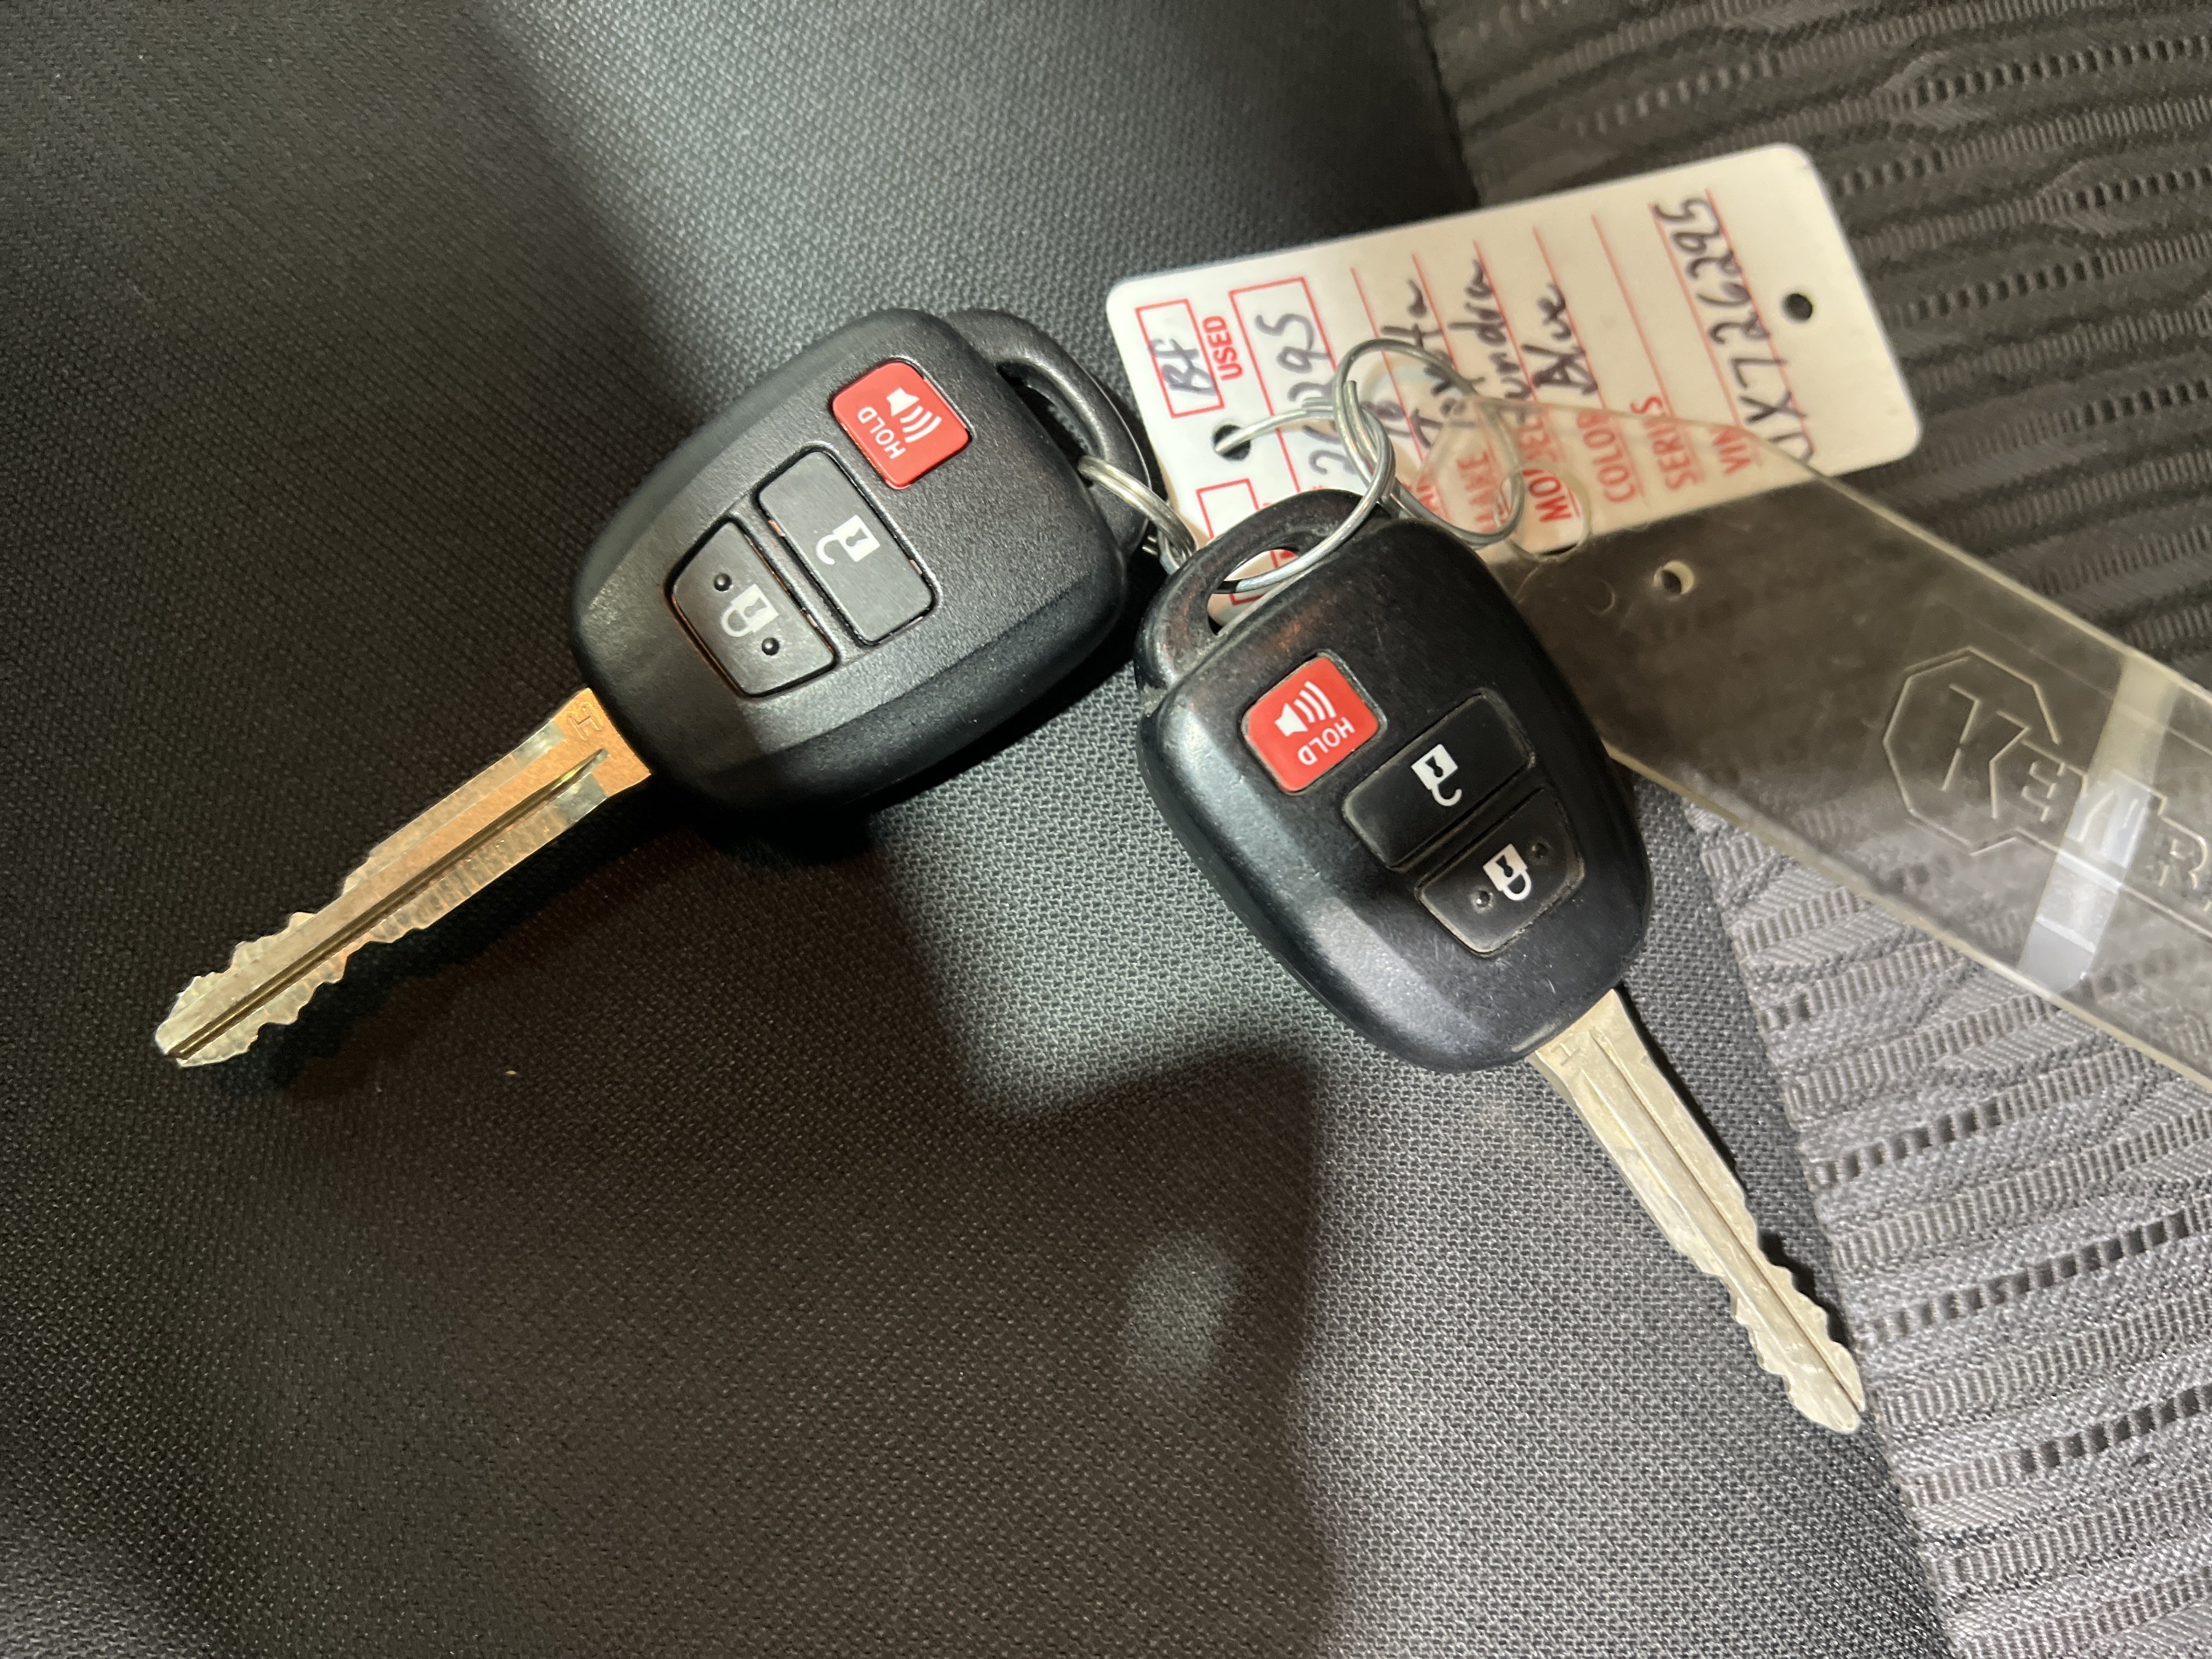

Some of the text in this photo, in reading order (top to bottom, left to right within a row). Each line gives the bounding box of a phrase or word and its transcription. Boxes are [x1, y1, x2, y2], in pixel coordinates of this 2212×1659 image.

[1203, 315, 1243, 381] USED
[857, 406, 906, 459] HOLD
[1576, 410, 1636, 503] COLOR
[1708, 424, 1752, 475] VIN
[1297, 716, 1356, 765] HOLD
